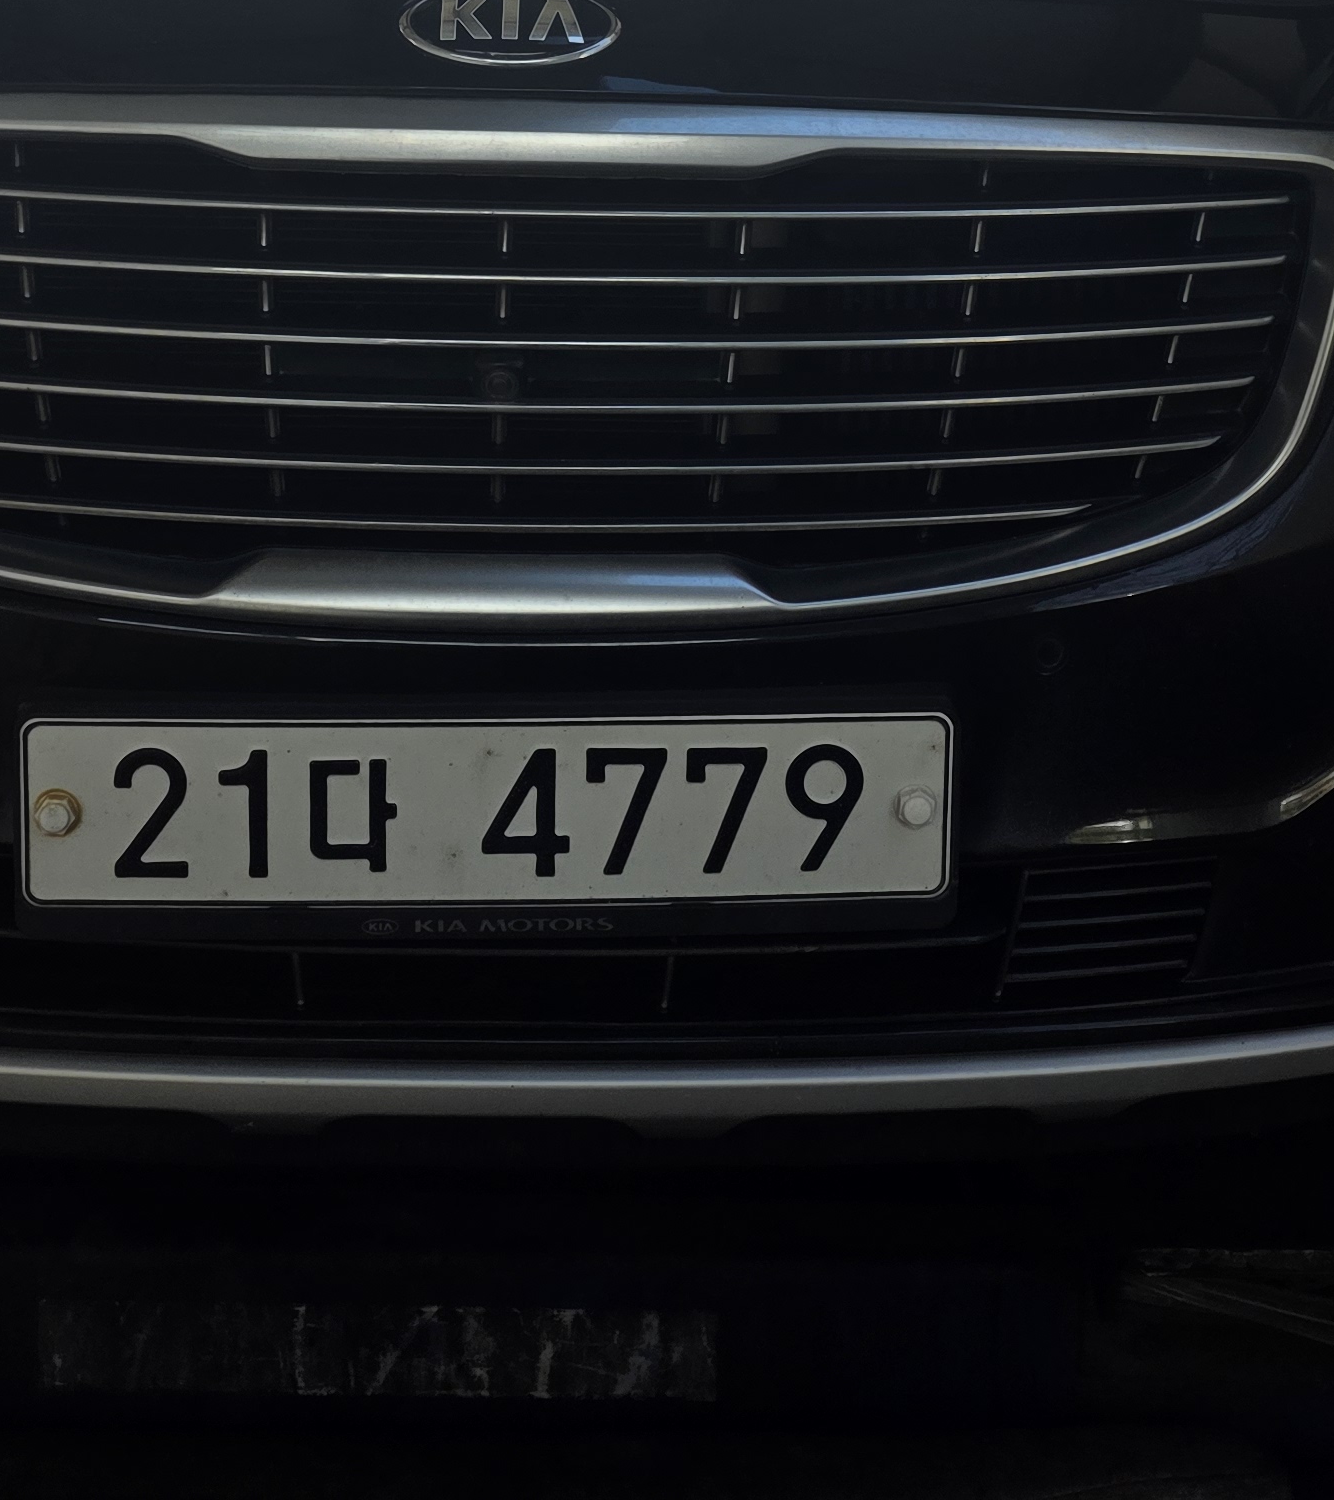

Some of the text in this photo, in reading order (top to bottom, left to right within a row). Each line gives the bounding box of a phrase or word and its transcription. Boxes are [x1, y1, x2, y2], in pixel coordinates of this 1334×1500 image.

[112, 742, 865, 879] 21다 4779
[414, 916, 615, 933] KIA MOTORS
